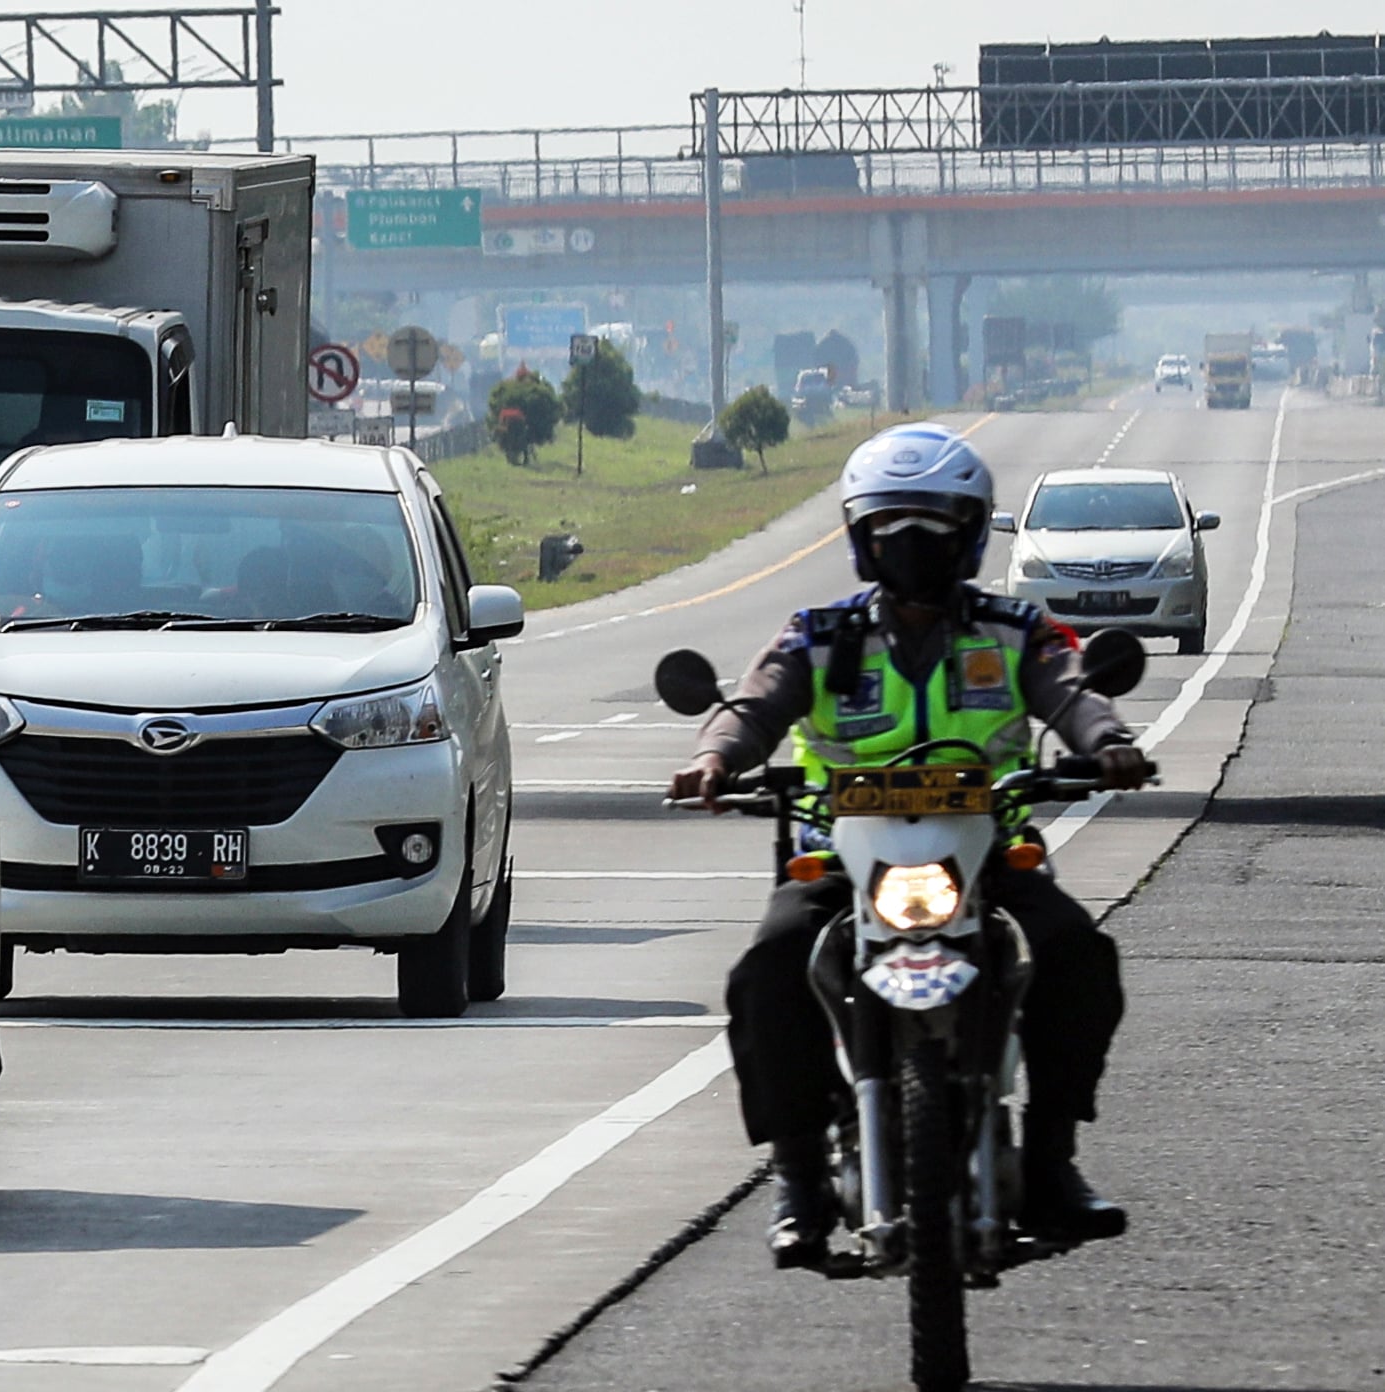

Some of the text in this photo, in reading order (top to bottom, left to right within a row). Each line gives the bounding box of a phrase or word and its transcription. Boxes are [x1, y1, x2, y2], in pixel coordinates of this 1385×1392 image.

[86, 832, 242, 862] K 8839 RH
